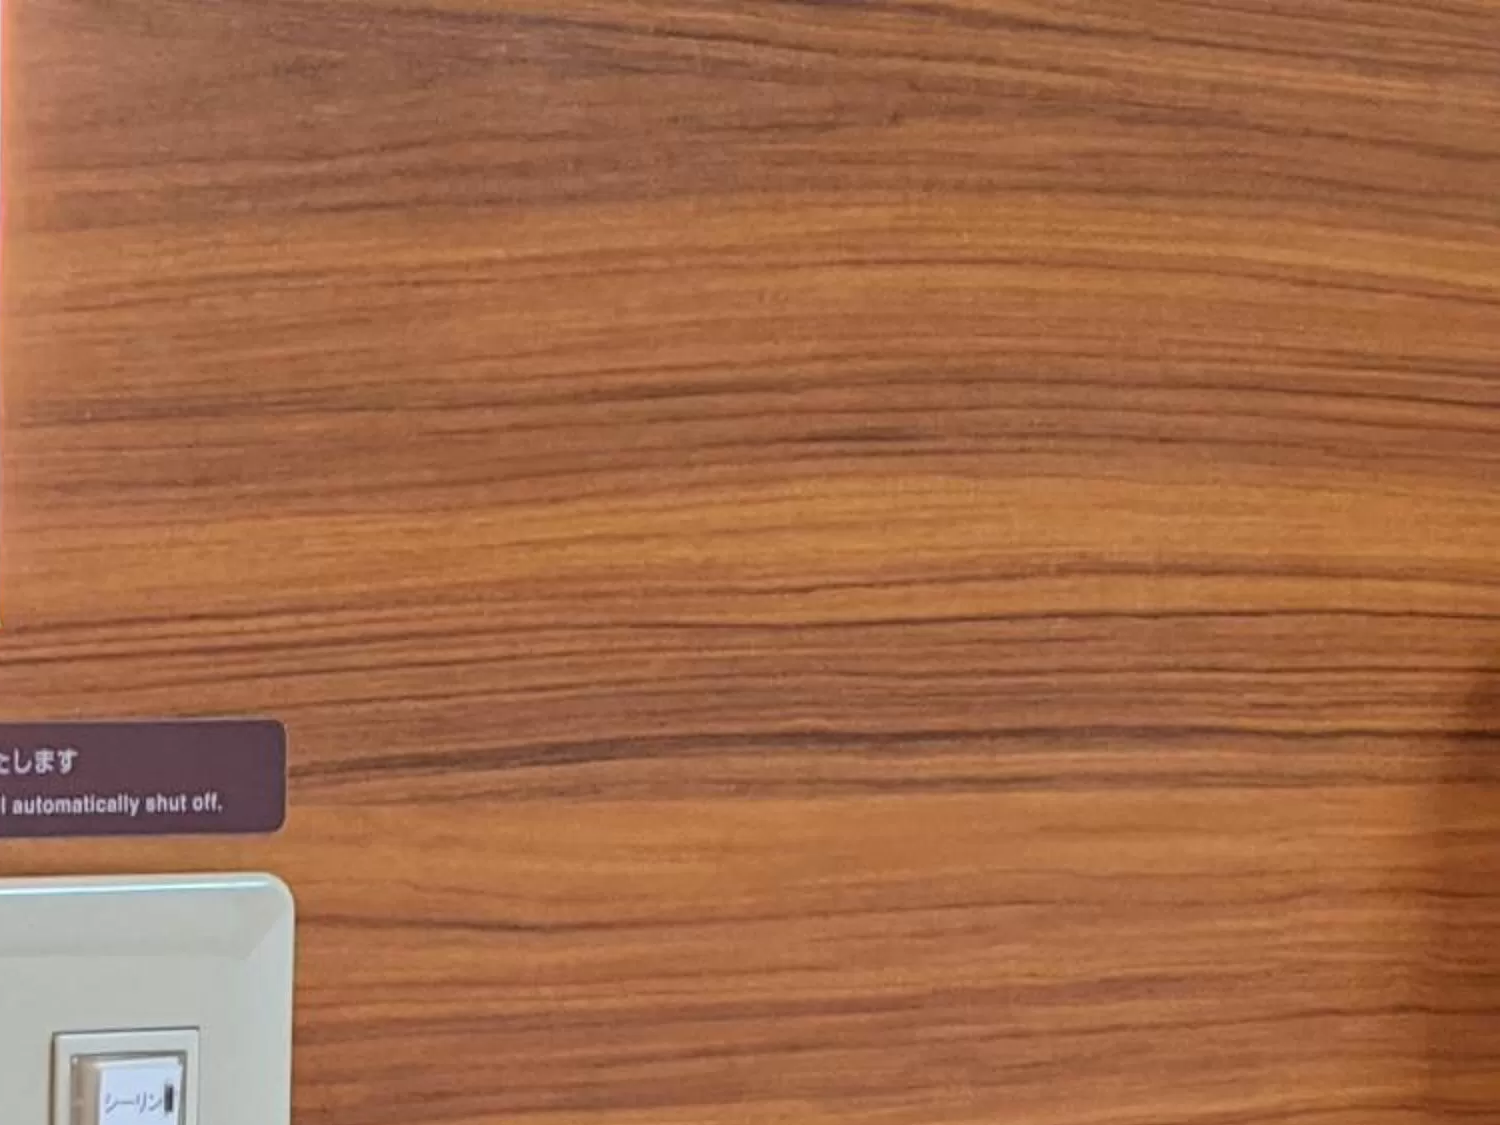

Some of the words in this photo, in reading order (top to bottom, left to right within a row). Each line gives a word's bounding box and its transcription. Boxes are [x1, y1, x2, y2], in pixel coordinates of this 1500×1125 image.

[12, 793, 140, 817] automatically
[145, 792, 188, 813] shut
[192, 791, 224, 813] off.
